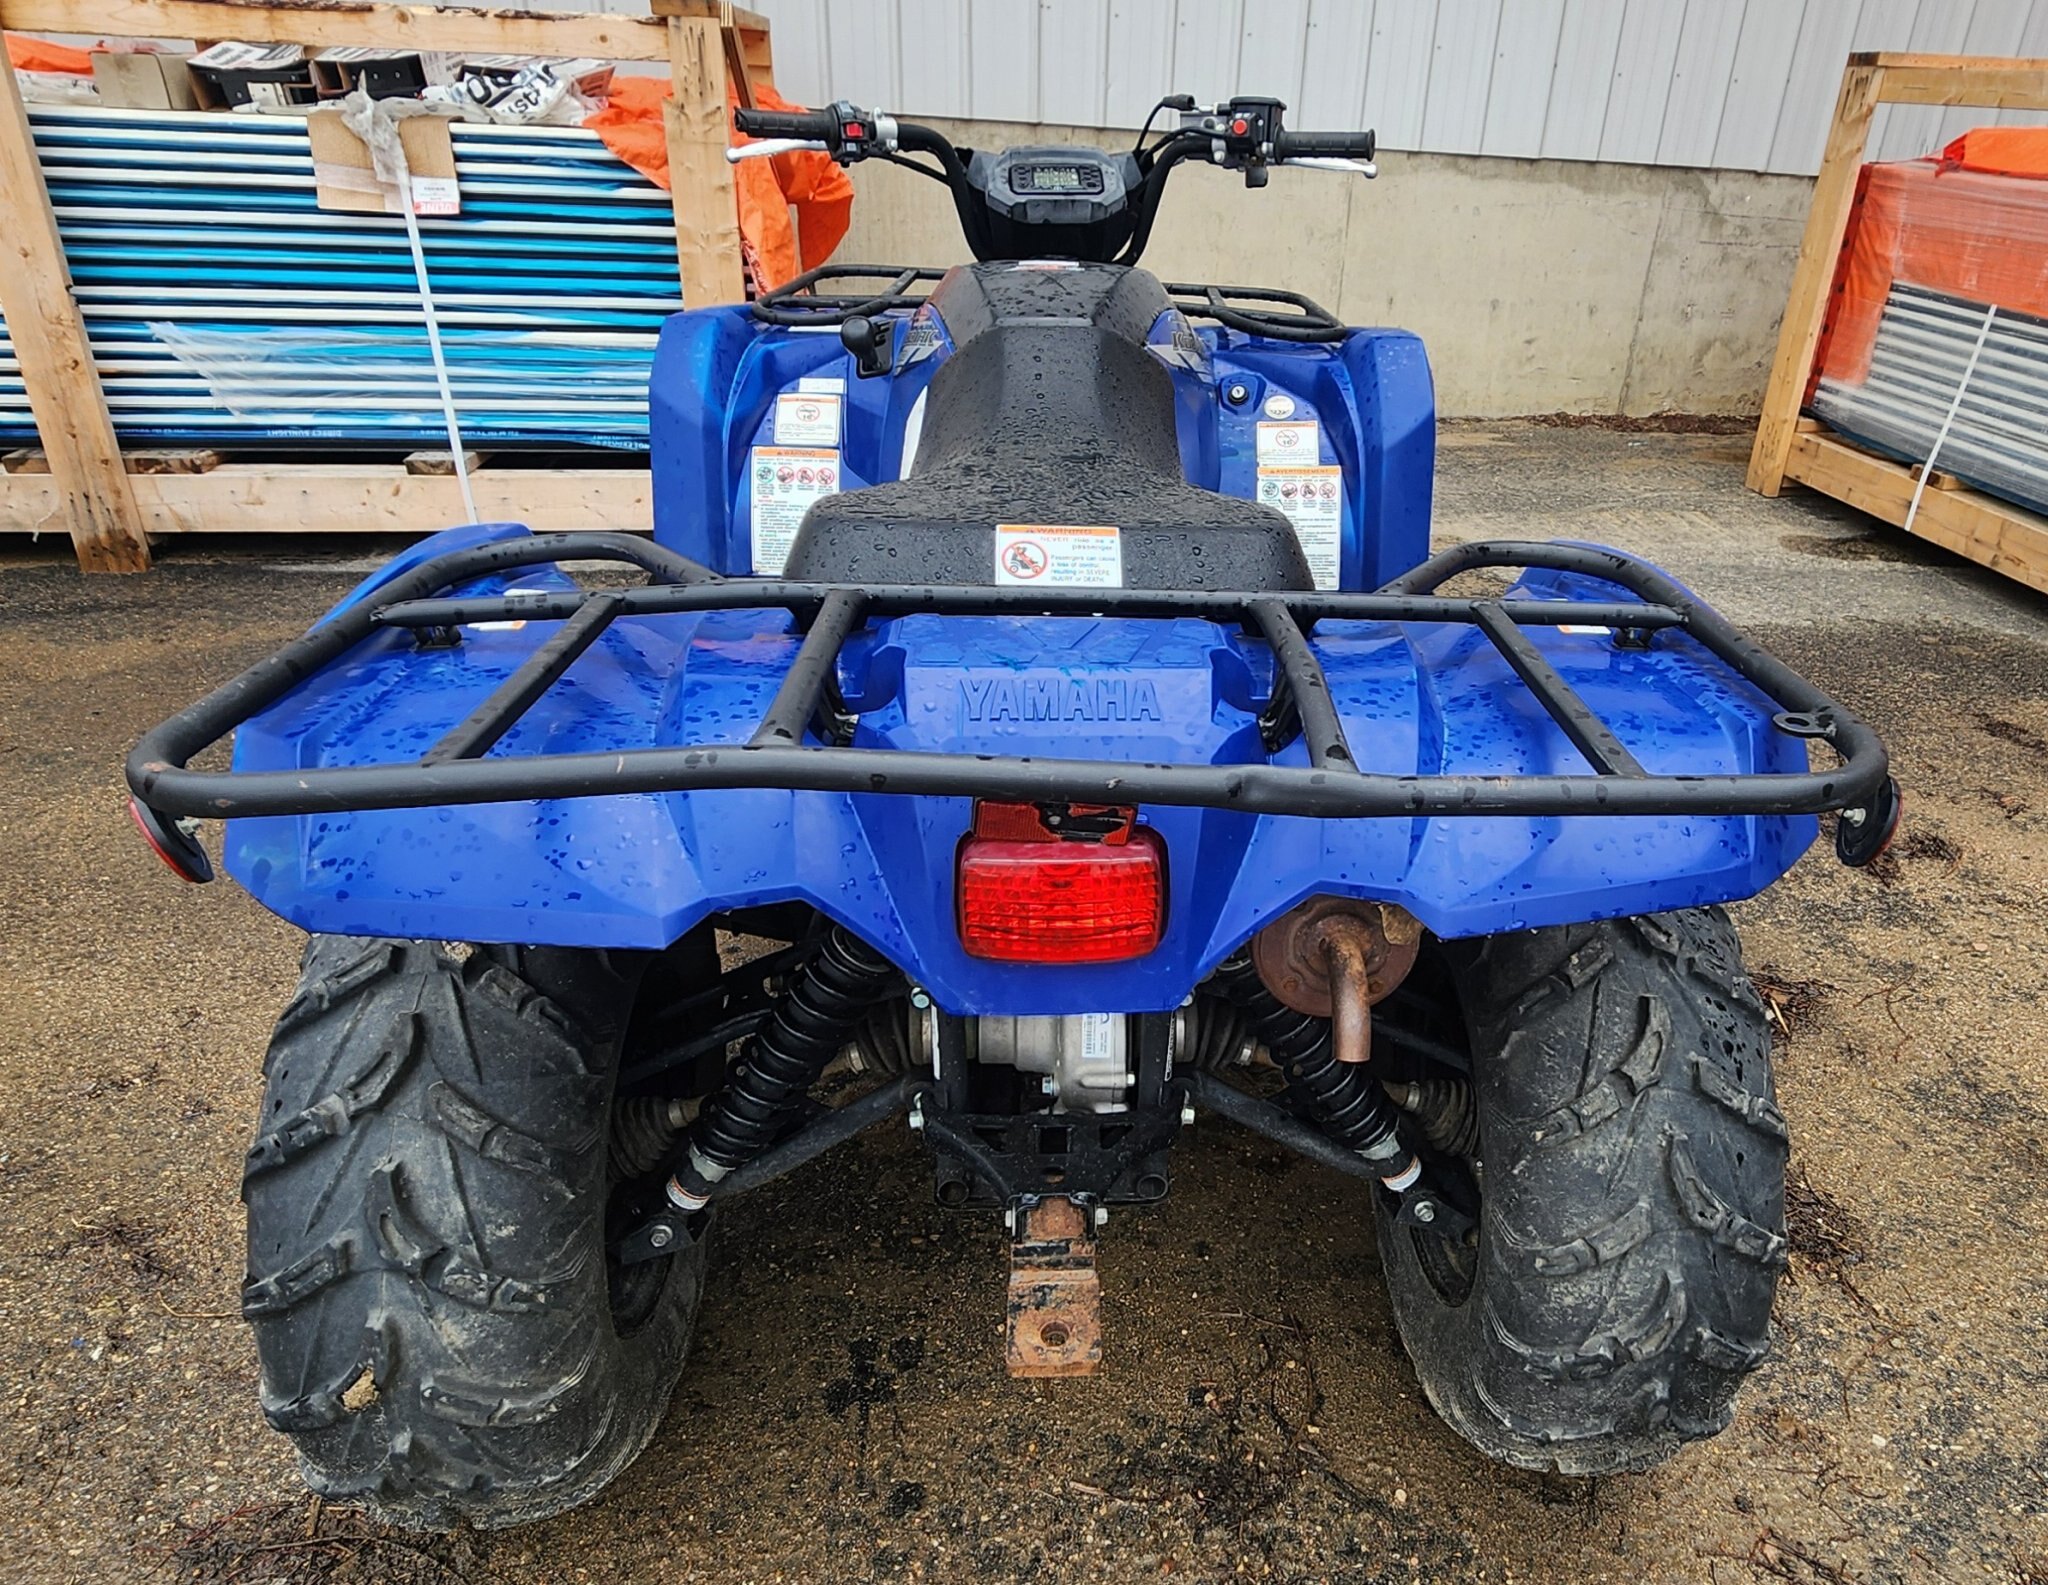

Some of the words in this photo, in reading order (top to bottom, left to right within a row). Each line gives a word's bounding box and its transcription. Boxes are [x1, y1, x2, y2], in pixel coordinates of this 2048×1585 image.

[784, 449, 816, 457] WARNING
[1037, 527, 1093, 535] WARNING
[959, 678, 1161, 723] YAMAHA
